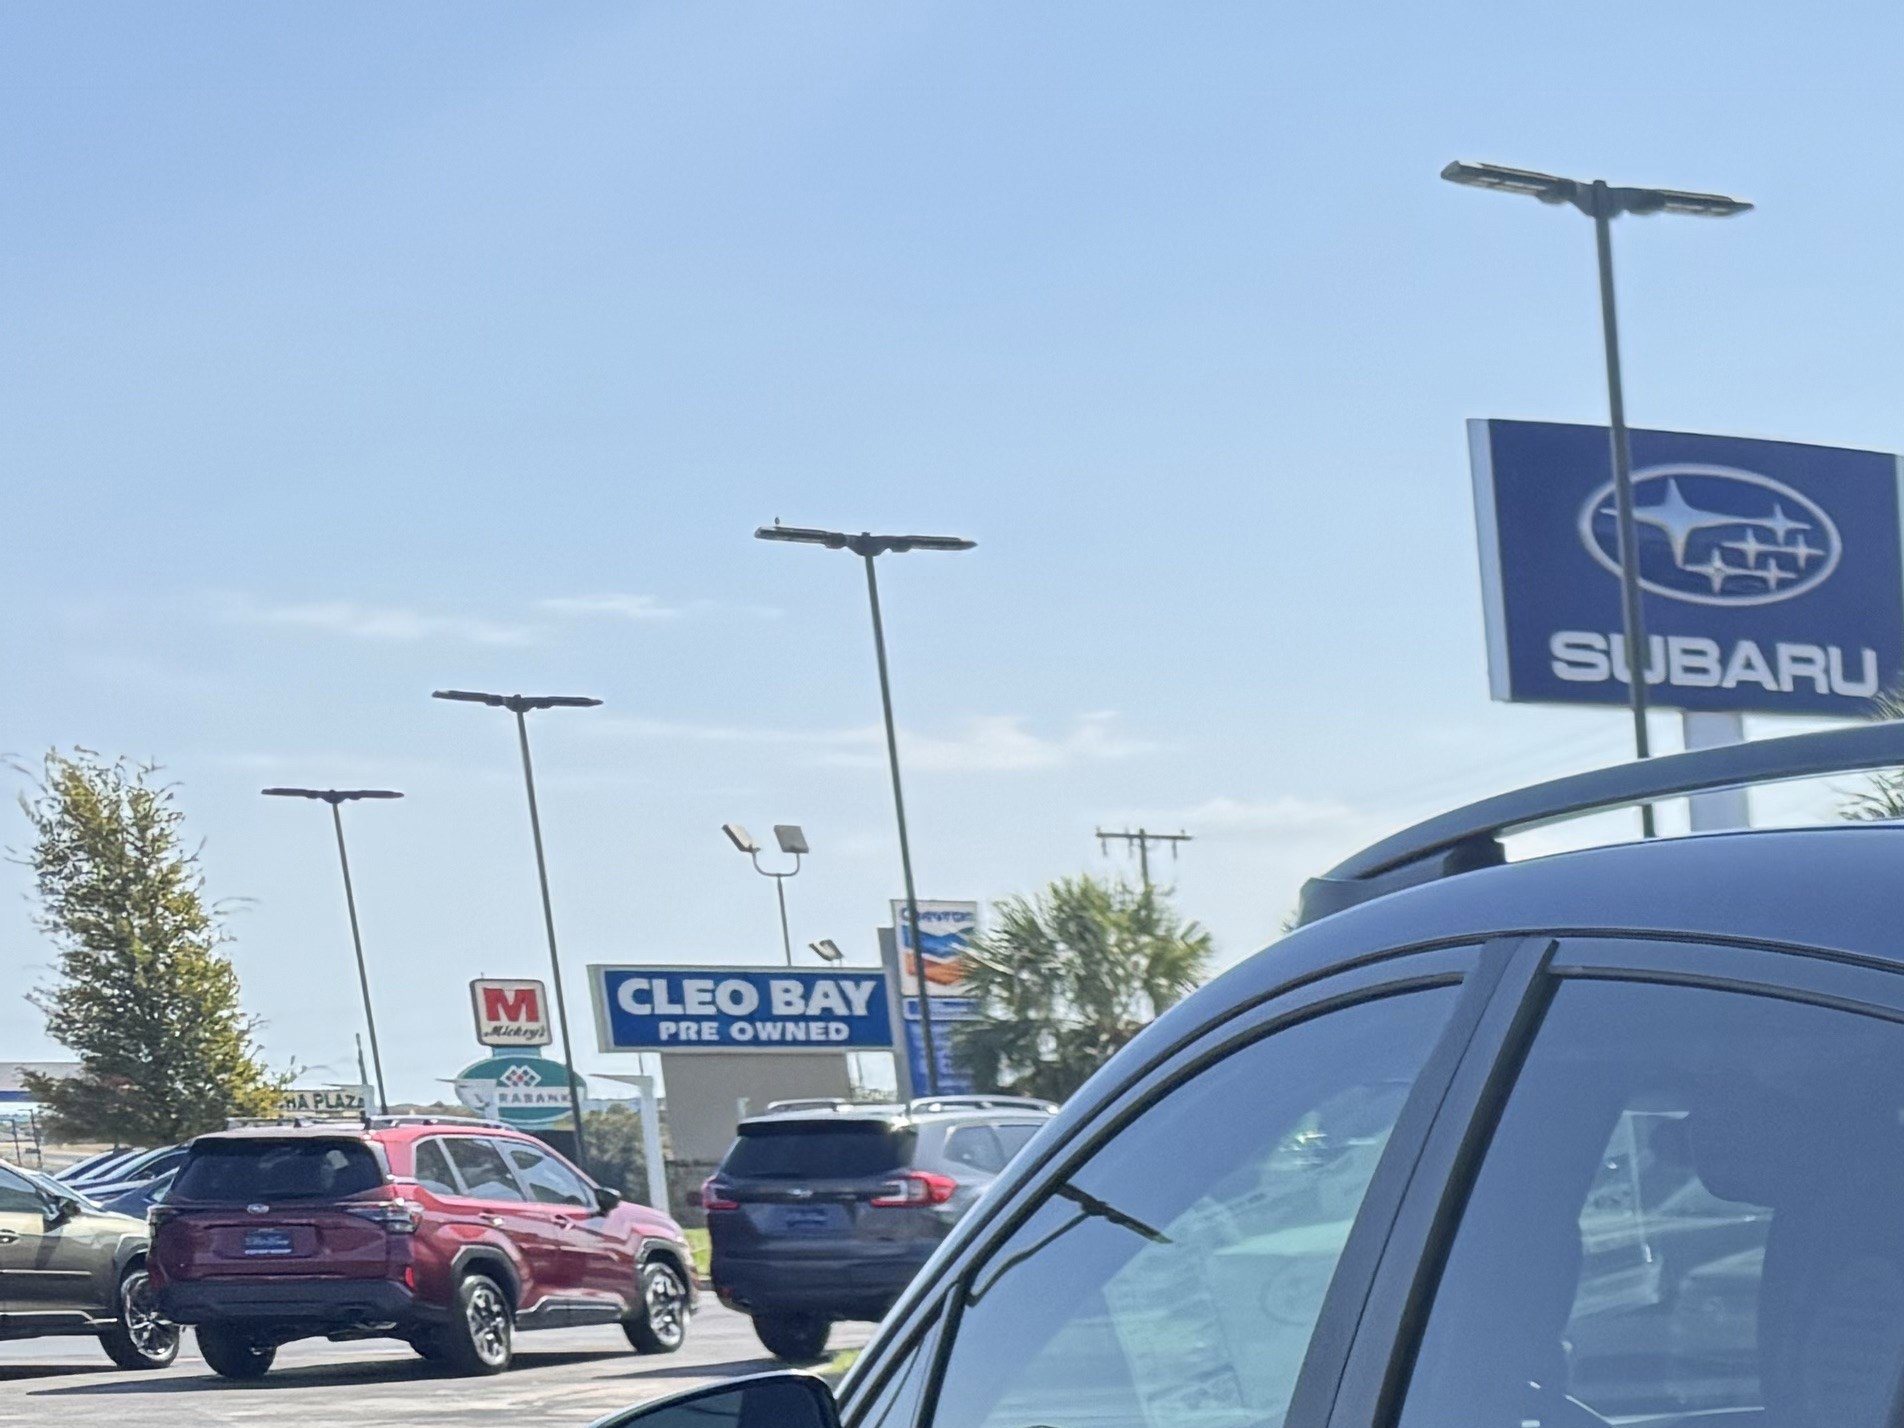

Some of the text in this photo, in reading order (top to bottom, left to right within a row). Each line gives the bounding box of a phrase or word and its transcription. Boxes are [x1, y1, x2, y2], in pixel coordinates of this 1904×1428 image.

[1549, 631, 1878, 698] SUBARU
[483, 988, 539, 1022] M
[617, 978, 759, 1016] CLEO
[769, 980, 877, 1016] BAY
[659, 1022, 849, 1041] PRE OWNED
